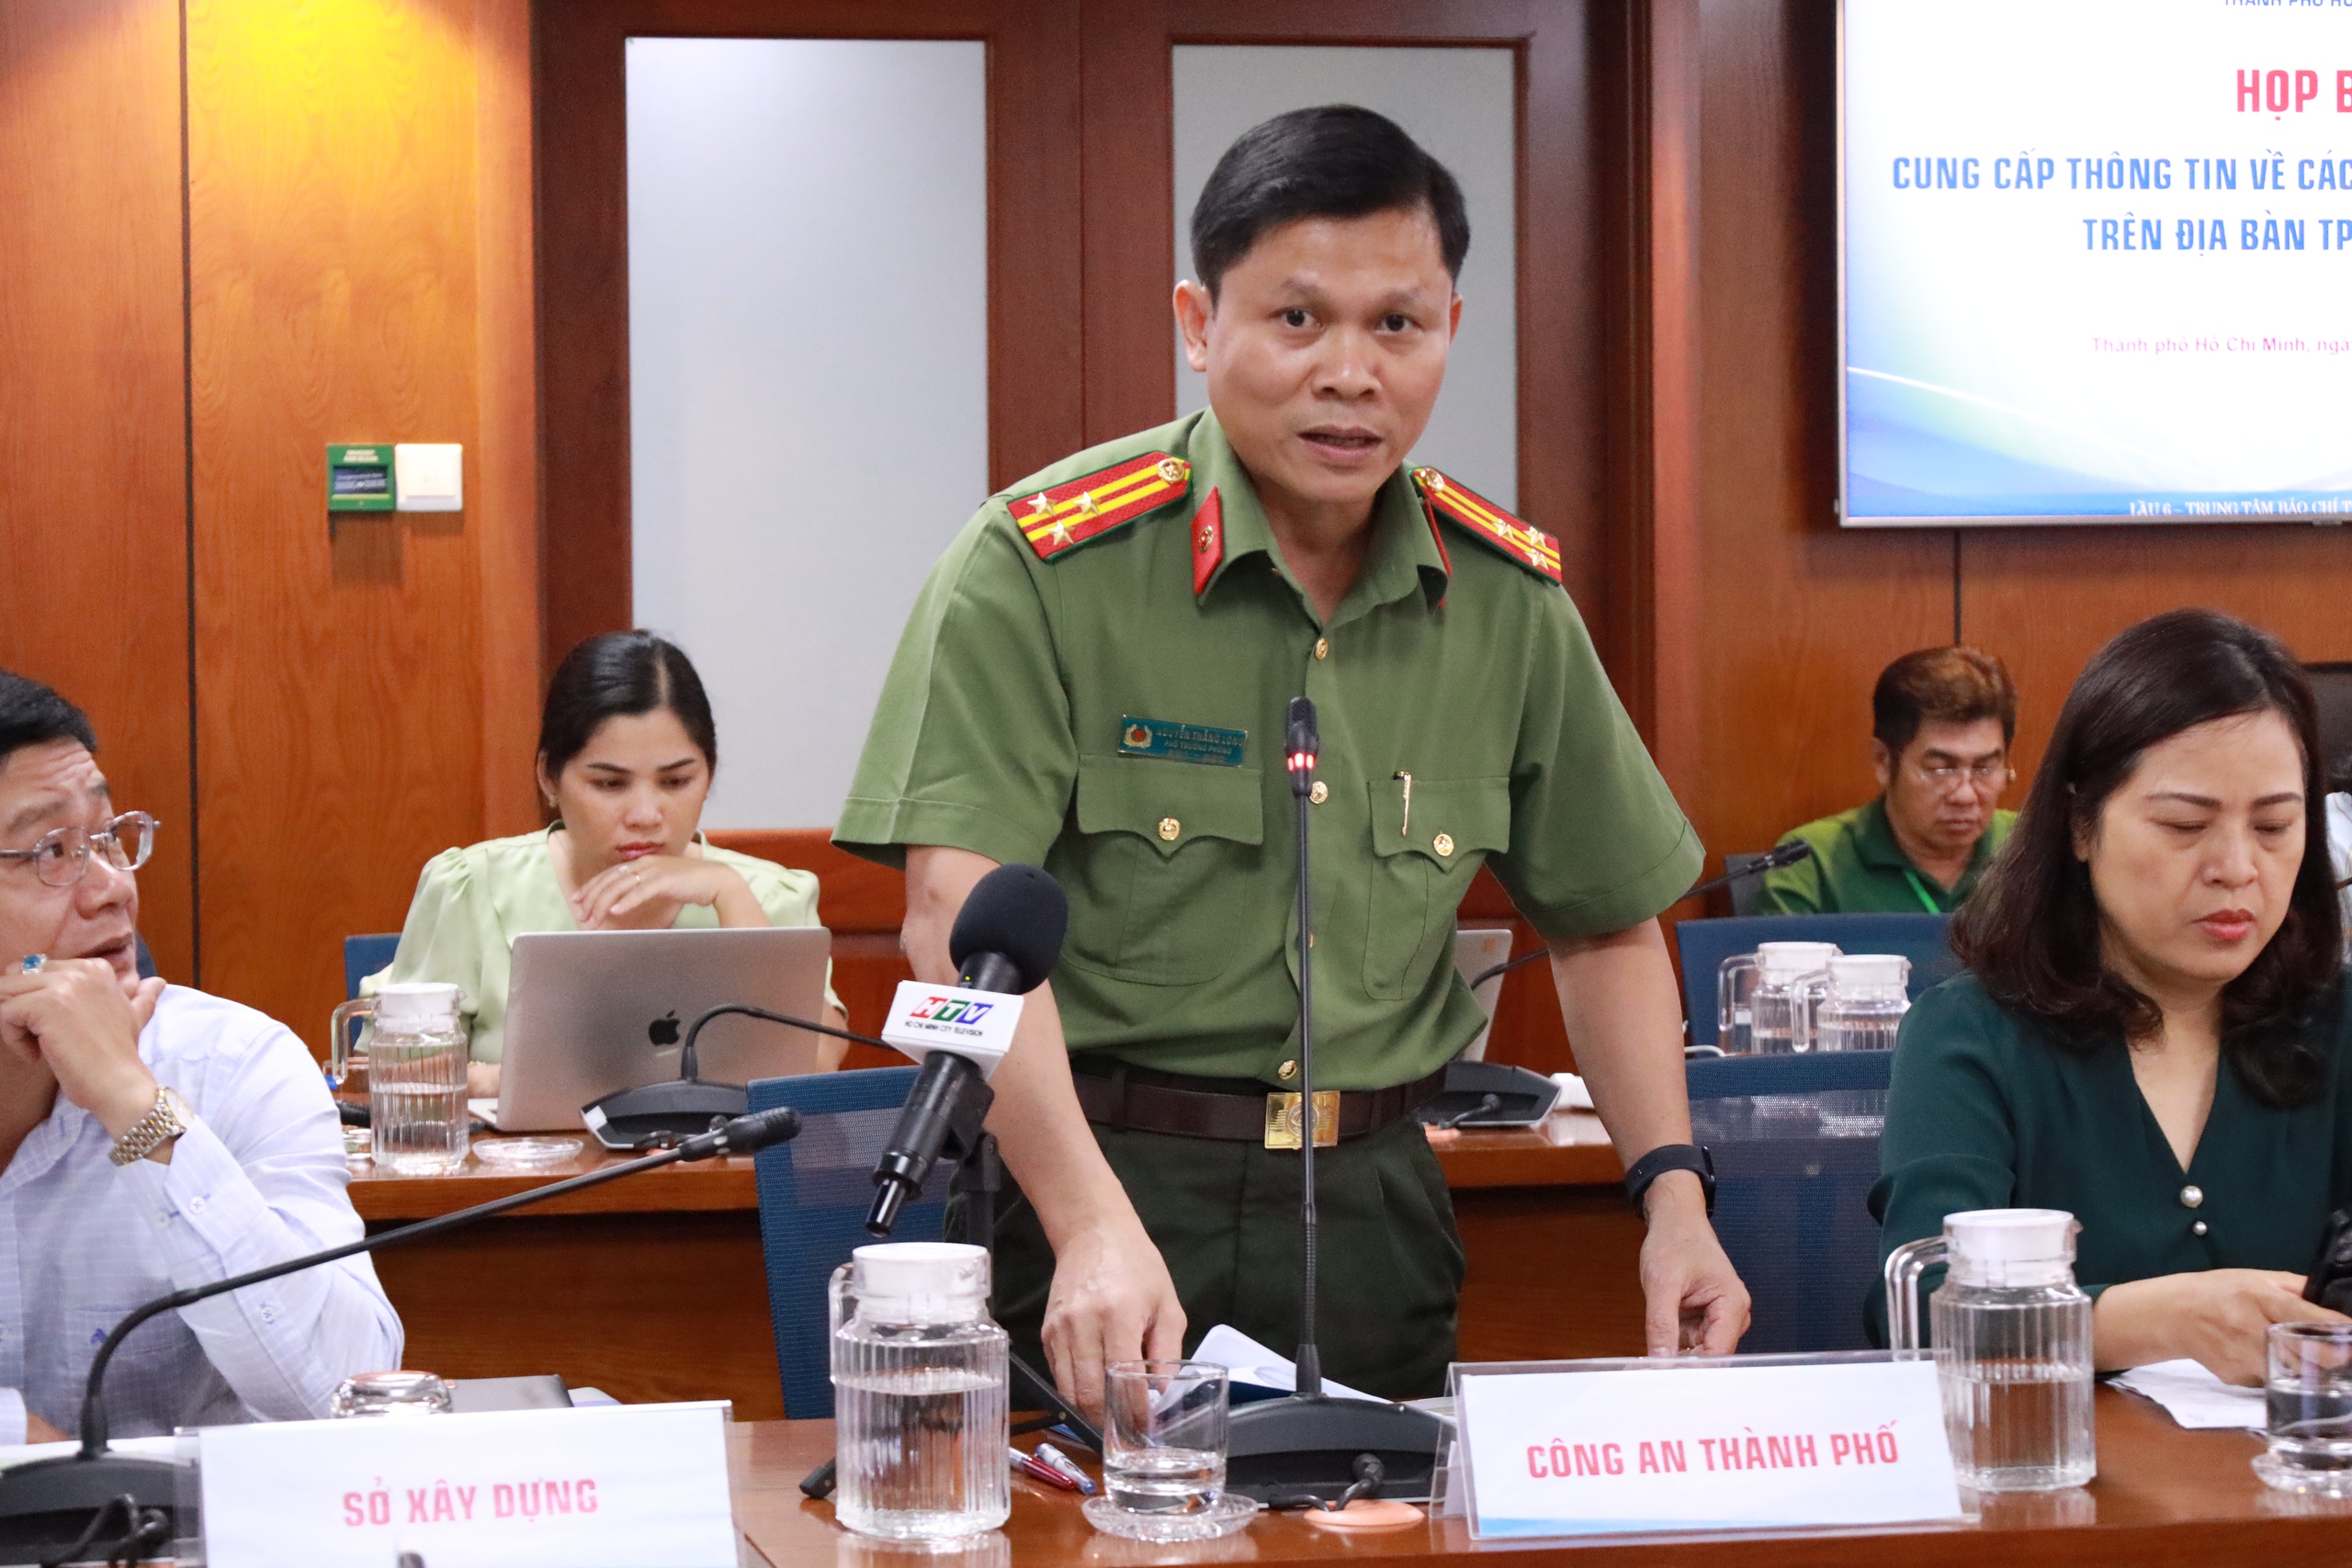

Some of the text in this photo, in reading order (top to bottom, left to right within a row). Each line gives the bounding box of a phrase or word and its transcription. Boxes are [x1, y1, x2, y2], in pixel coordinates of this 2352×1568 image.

[2236, 69, 2319, 120] HỌP
[1892, 147, 2352, 190] CUNG CẤP THÔNG TIN VỀ CÁC
[2083, 211, 2163, 251] TRÊN
[2175, 218, 2228, 256] ĐỊA
[2240, 209, 2306, 251] BÀN
[2092, 335, 2148, 353] Thành
[2195, 333, 2220, 352] Hồ
[2262, 337, 2311, 353] Minh,
[2317, 336, 2352, 355] ngà
[2185, 502, 2239, 515] TRUNG
[2241, 498, 2274, 515] TÂM
[2278, 497, 2309, 515] BÁO
[2312, 497, 2338, 514] CHÍ
[909, 996, 995, 1025] HTV
[939, 1024, 953, 1032] CITY
[954, 1026, 984, 1037] TELEVISION
[1526, 1420, 1899, 1478] CÔNG AN THÀNH PHỐ
[343, 1476, 599, 1527] SỞ XÂY DỰNG
